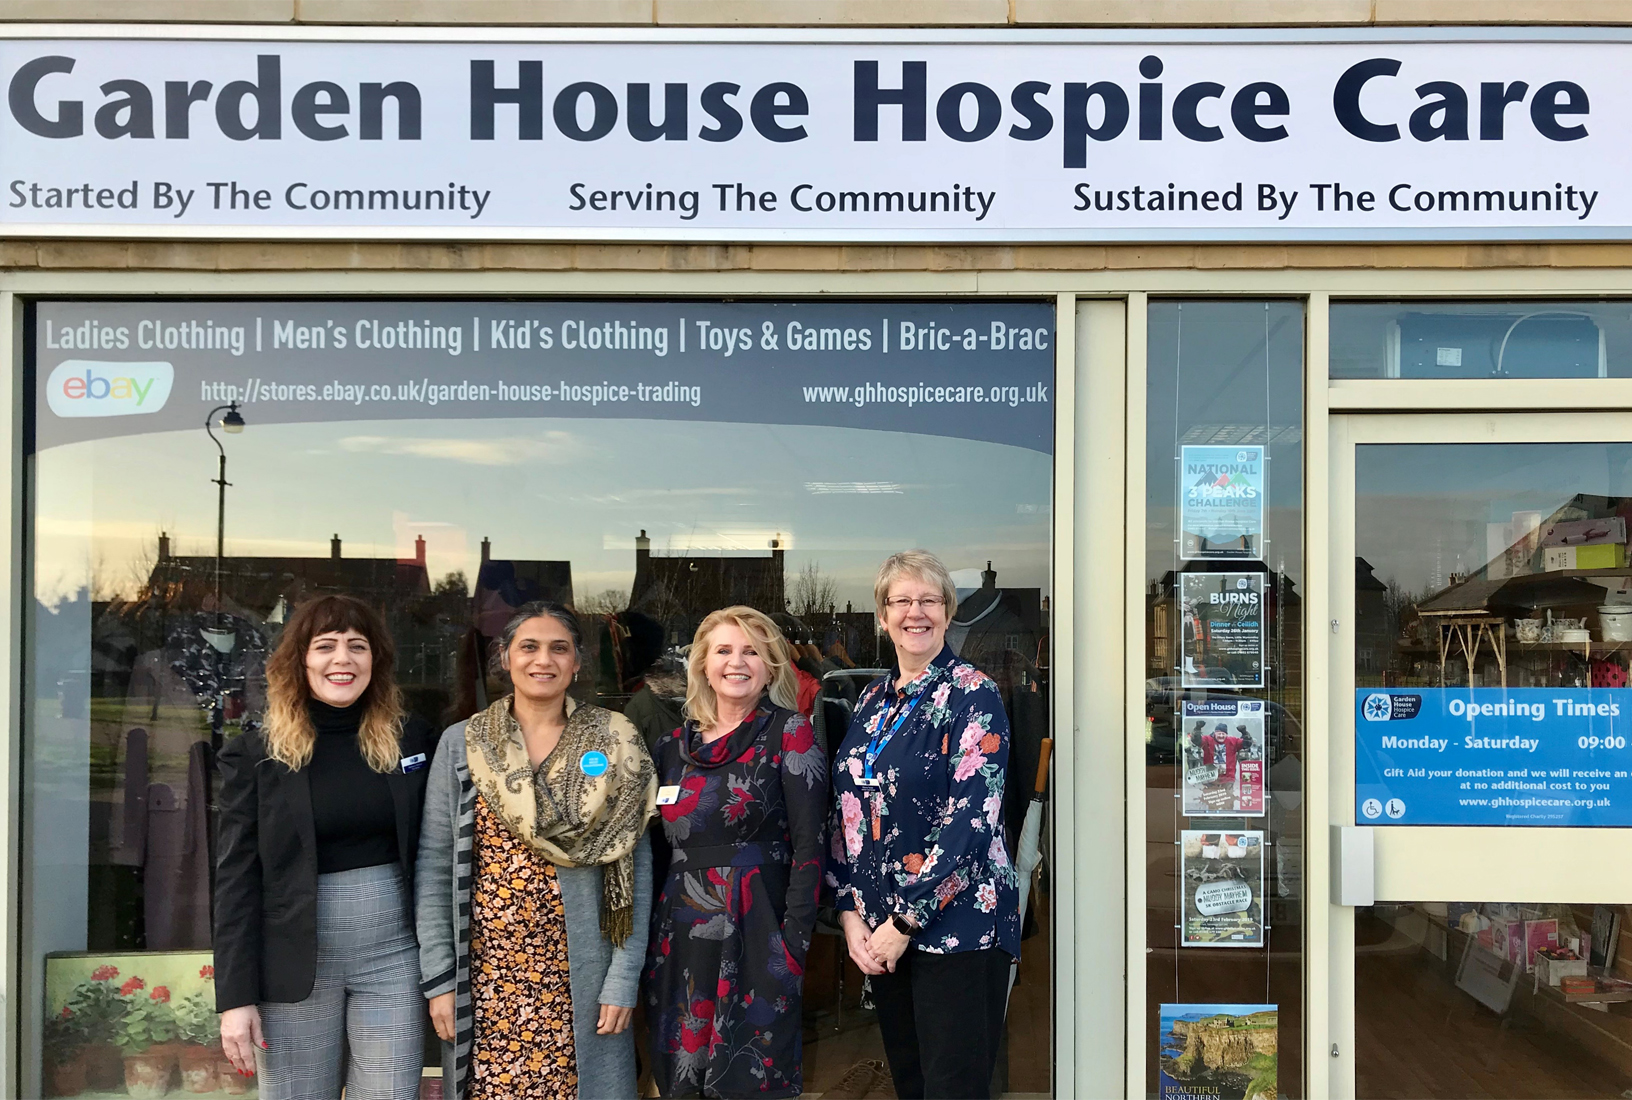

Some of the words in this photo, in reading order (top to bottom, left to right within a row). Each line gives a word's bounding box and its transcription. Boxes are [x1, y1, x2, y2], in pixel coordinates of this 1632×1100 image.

[9, 55, 421, 141] Garden
[471, 60, 808, 142] House
[854, 55, 1289, 168] Hospice
[1334, 58, 1589, 142] Care
[9, 181, 138, 209] Started
[153, 183, 195, 218] By
[206, 182, 272, 210] The
[286, 183, 491, 219] Community
[568, 183, 699, 220] Serving
[712, 183, 777, 211] The
[791, 184, 996, 220] Community
[1074, 183, 1243, 211] Sustained
[1257, 184, 1299, 220] By
[1310, 183, 1376, 211] The
[1388, 183, 1598, 219] Community
[46, 319, 130, 350] Ladies
[138, 319, 245, 356] Clothing
[273, 319, 347, 349] Men's
[355, 319, 462, 356] Clothing
[491, 319, 554, 350] Kid's
[561, 319, 668, 357] Clothing
[696, 320, 753, 357] Toys
[761, 321, 780, 351] &
[787, 321, 872, 351] Games
[900, 321, 1049, 351] Bric-a-Brac
[62, 368, 154, 407] ebay
[201, 378, 701, 407] http://stores.ebay.co.uk/garden-house-hospice-trading
[803, 381, 1048, 408] www.ghhospicecare.org.uk
[1187, 464, 1257, 475] NATIONAL
[1188, 486, 1198, 498] 3
[1202, 486, 1257, 498] PEAKS
[1187, 498, 1257, 508] CHALLENGE
[1210, 592, 1259, 604] BURNS
[1220, 600, 1259, 621] Night
[1187, 703, 1210, 712] Open
[1210, 703, 1237, 711] House
[1449, 699, 1545, 721] Opening
[1553, 699, 1620, 716] Times
[1382, 736, 1449, 752] Monday
[1465, 736, 1540, 752] Saturday
[1577, 736, 1626, 750] 09:00
[1384, 768, 1406, 778] Gift
[1407, 768, 1426, 778] Aid
[1428, 770, 1453, 781] your
[1456, 768, 1504, 778] donation
[1507, 768, 1528, 778] and
[1531, 770, 1547, 778] we
[1550, 768, 1570, 778] will
[1573, 768, 1611, 778] receive
[1614, 770, 1628, 778] an
[1460, 781, 1472, 790] at
[1474, 782, 1489, 790] no
[1491, 781, 1547, 790] additional
[1550, 781, 1572, 790] cost
[1575, 781, 1588, 790] to
[1591, 782, 1610, 792] you
[1459, 797, 1611, 810] www.ghhospicecare.org.uk
[1224, 890, 1248, 900] MAYHEM
[1165, 1086, 1221, 1095] BEAUTIFUL
